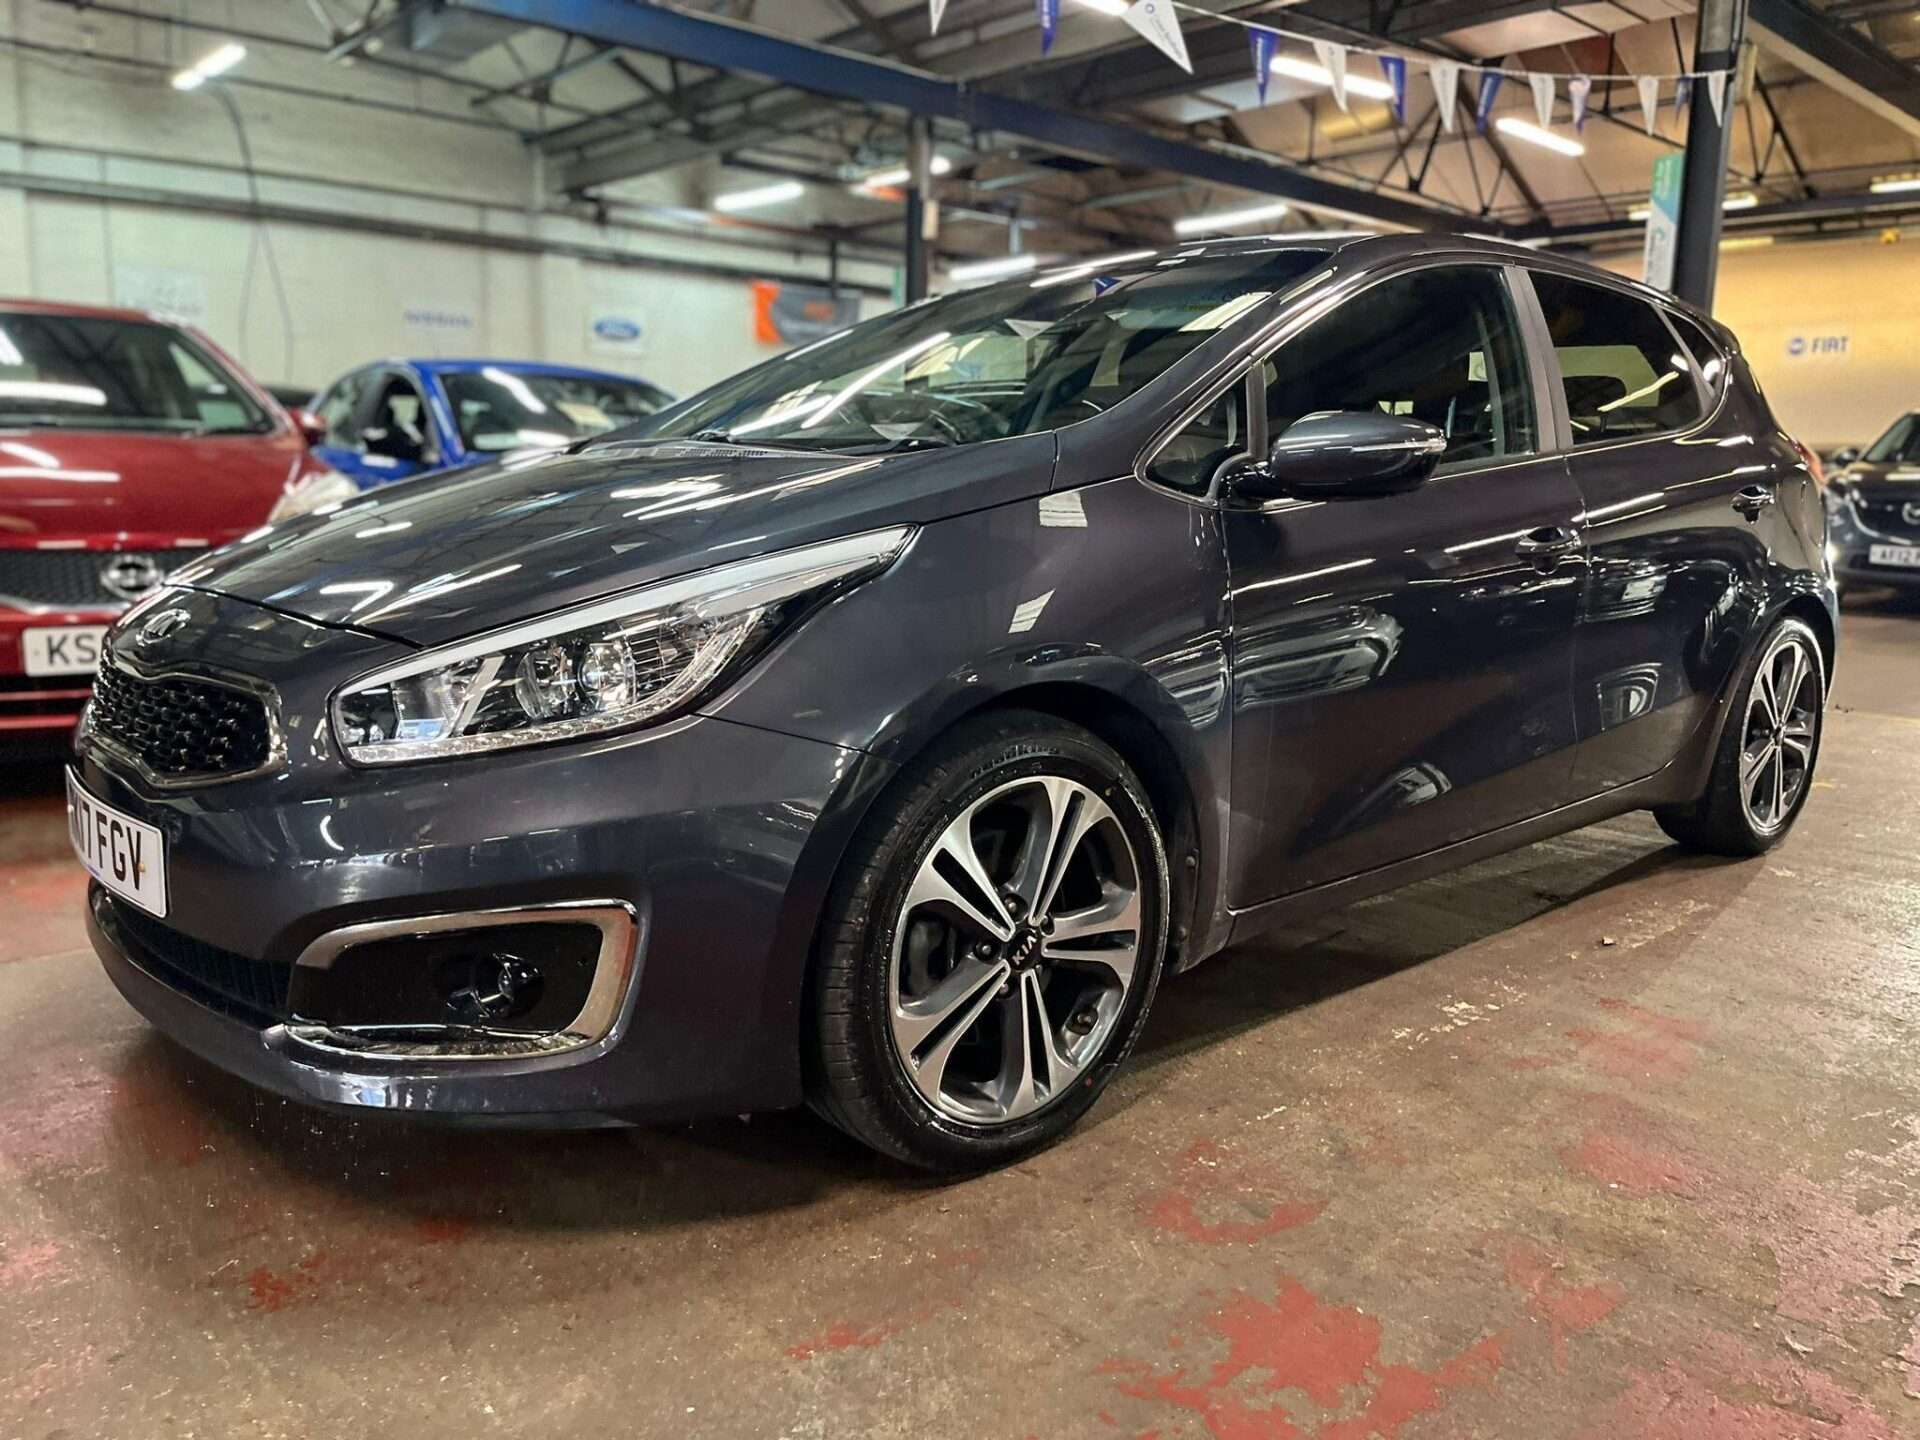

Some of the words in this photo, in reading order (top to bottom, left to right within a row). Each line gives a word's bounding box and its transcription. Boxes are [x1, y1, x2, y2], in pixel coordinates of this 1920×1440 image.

[1812, 336, 1848, 353] FIAT
[96, 810, 141, 891] FGV
[1012, 935, 1037, 966] KIA
